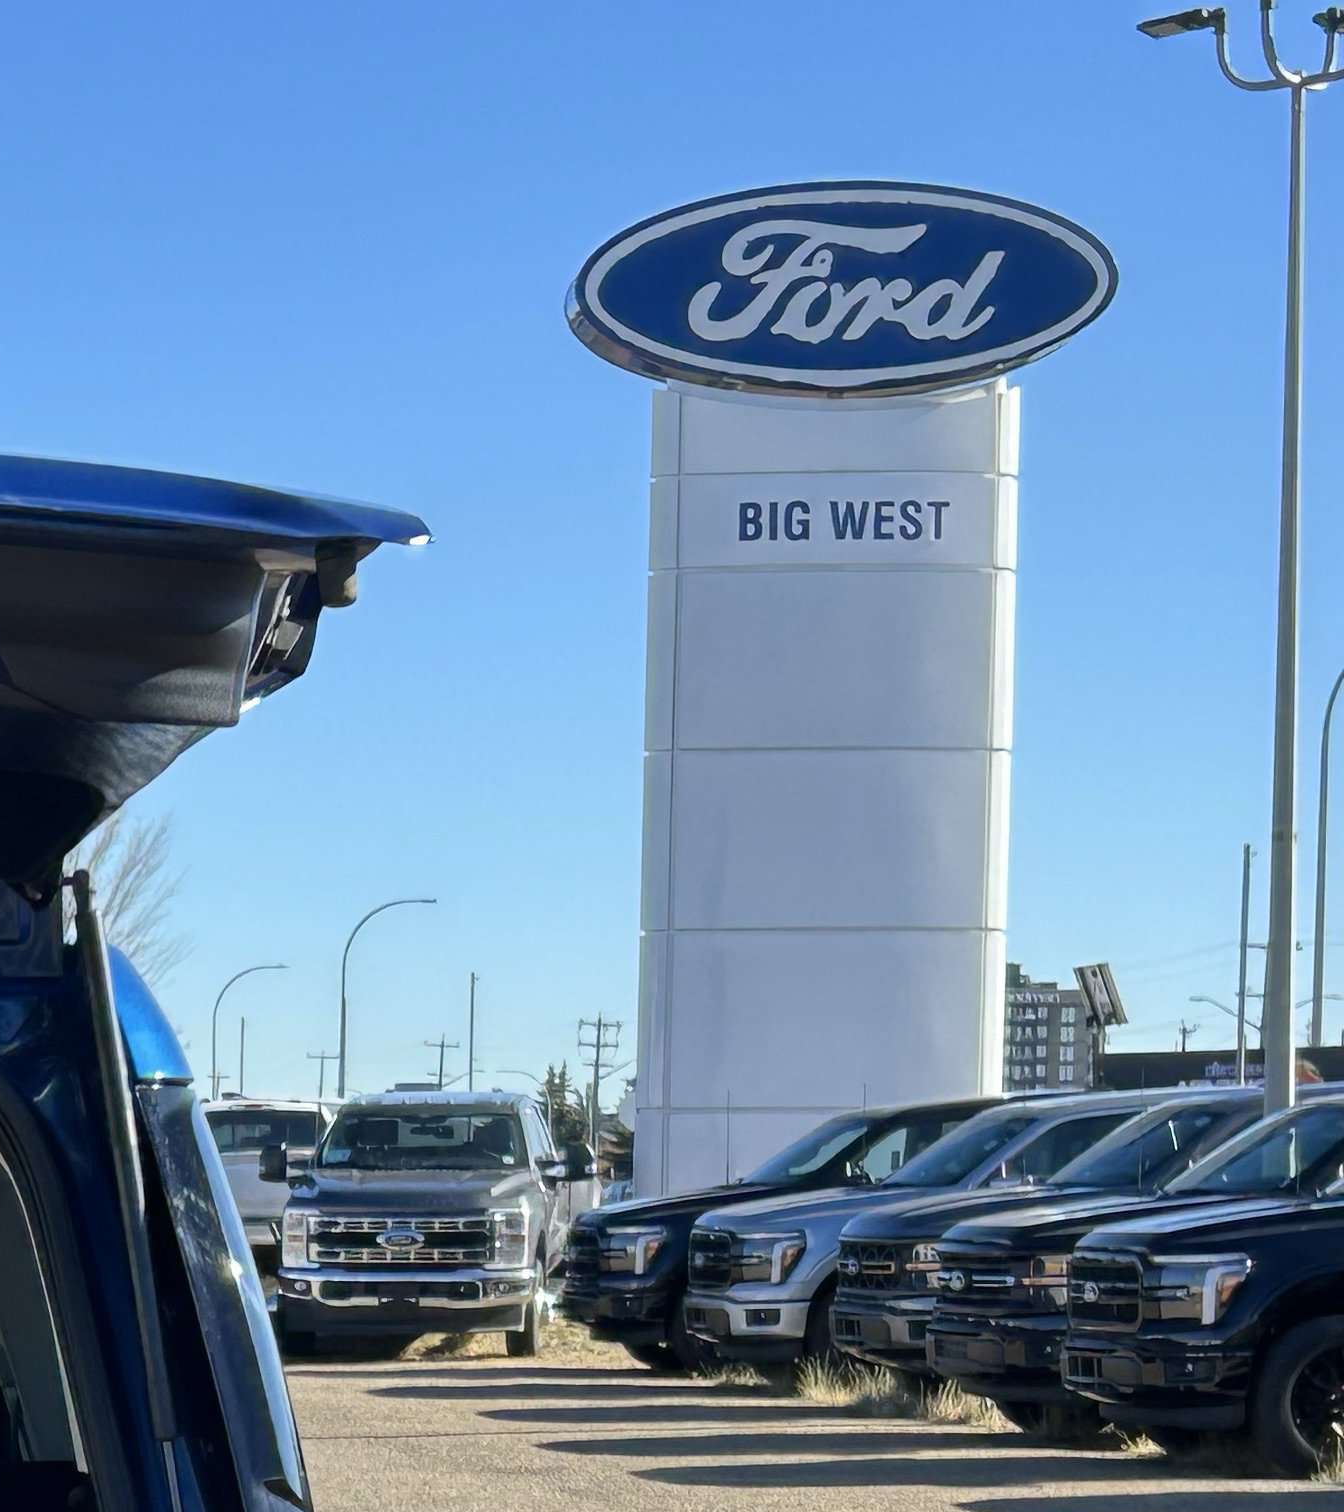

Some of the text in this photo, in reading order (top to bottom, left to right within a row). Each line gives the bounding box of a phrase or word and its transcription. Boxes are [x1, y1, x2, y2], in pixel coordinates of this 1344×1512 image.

[687, 219, 1006, 344] Ford
[738, 500, 951, 542] BIG WEST
